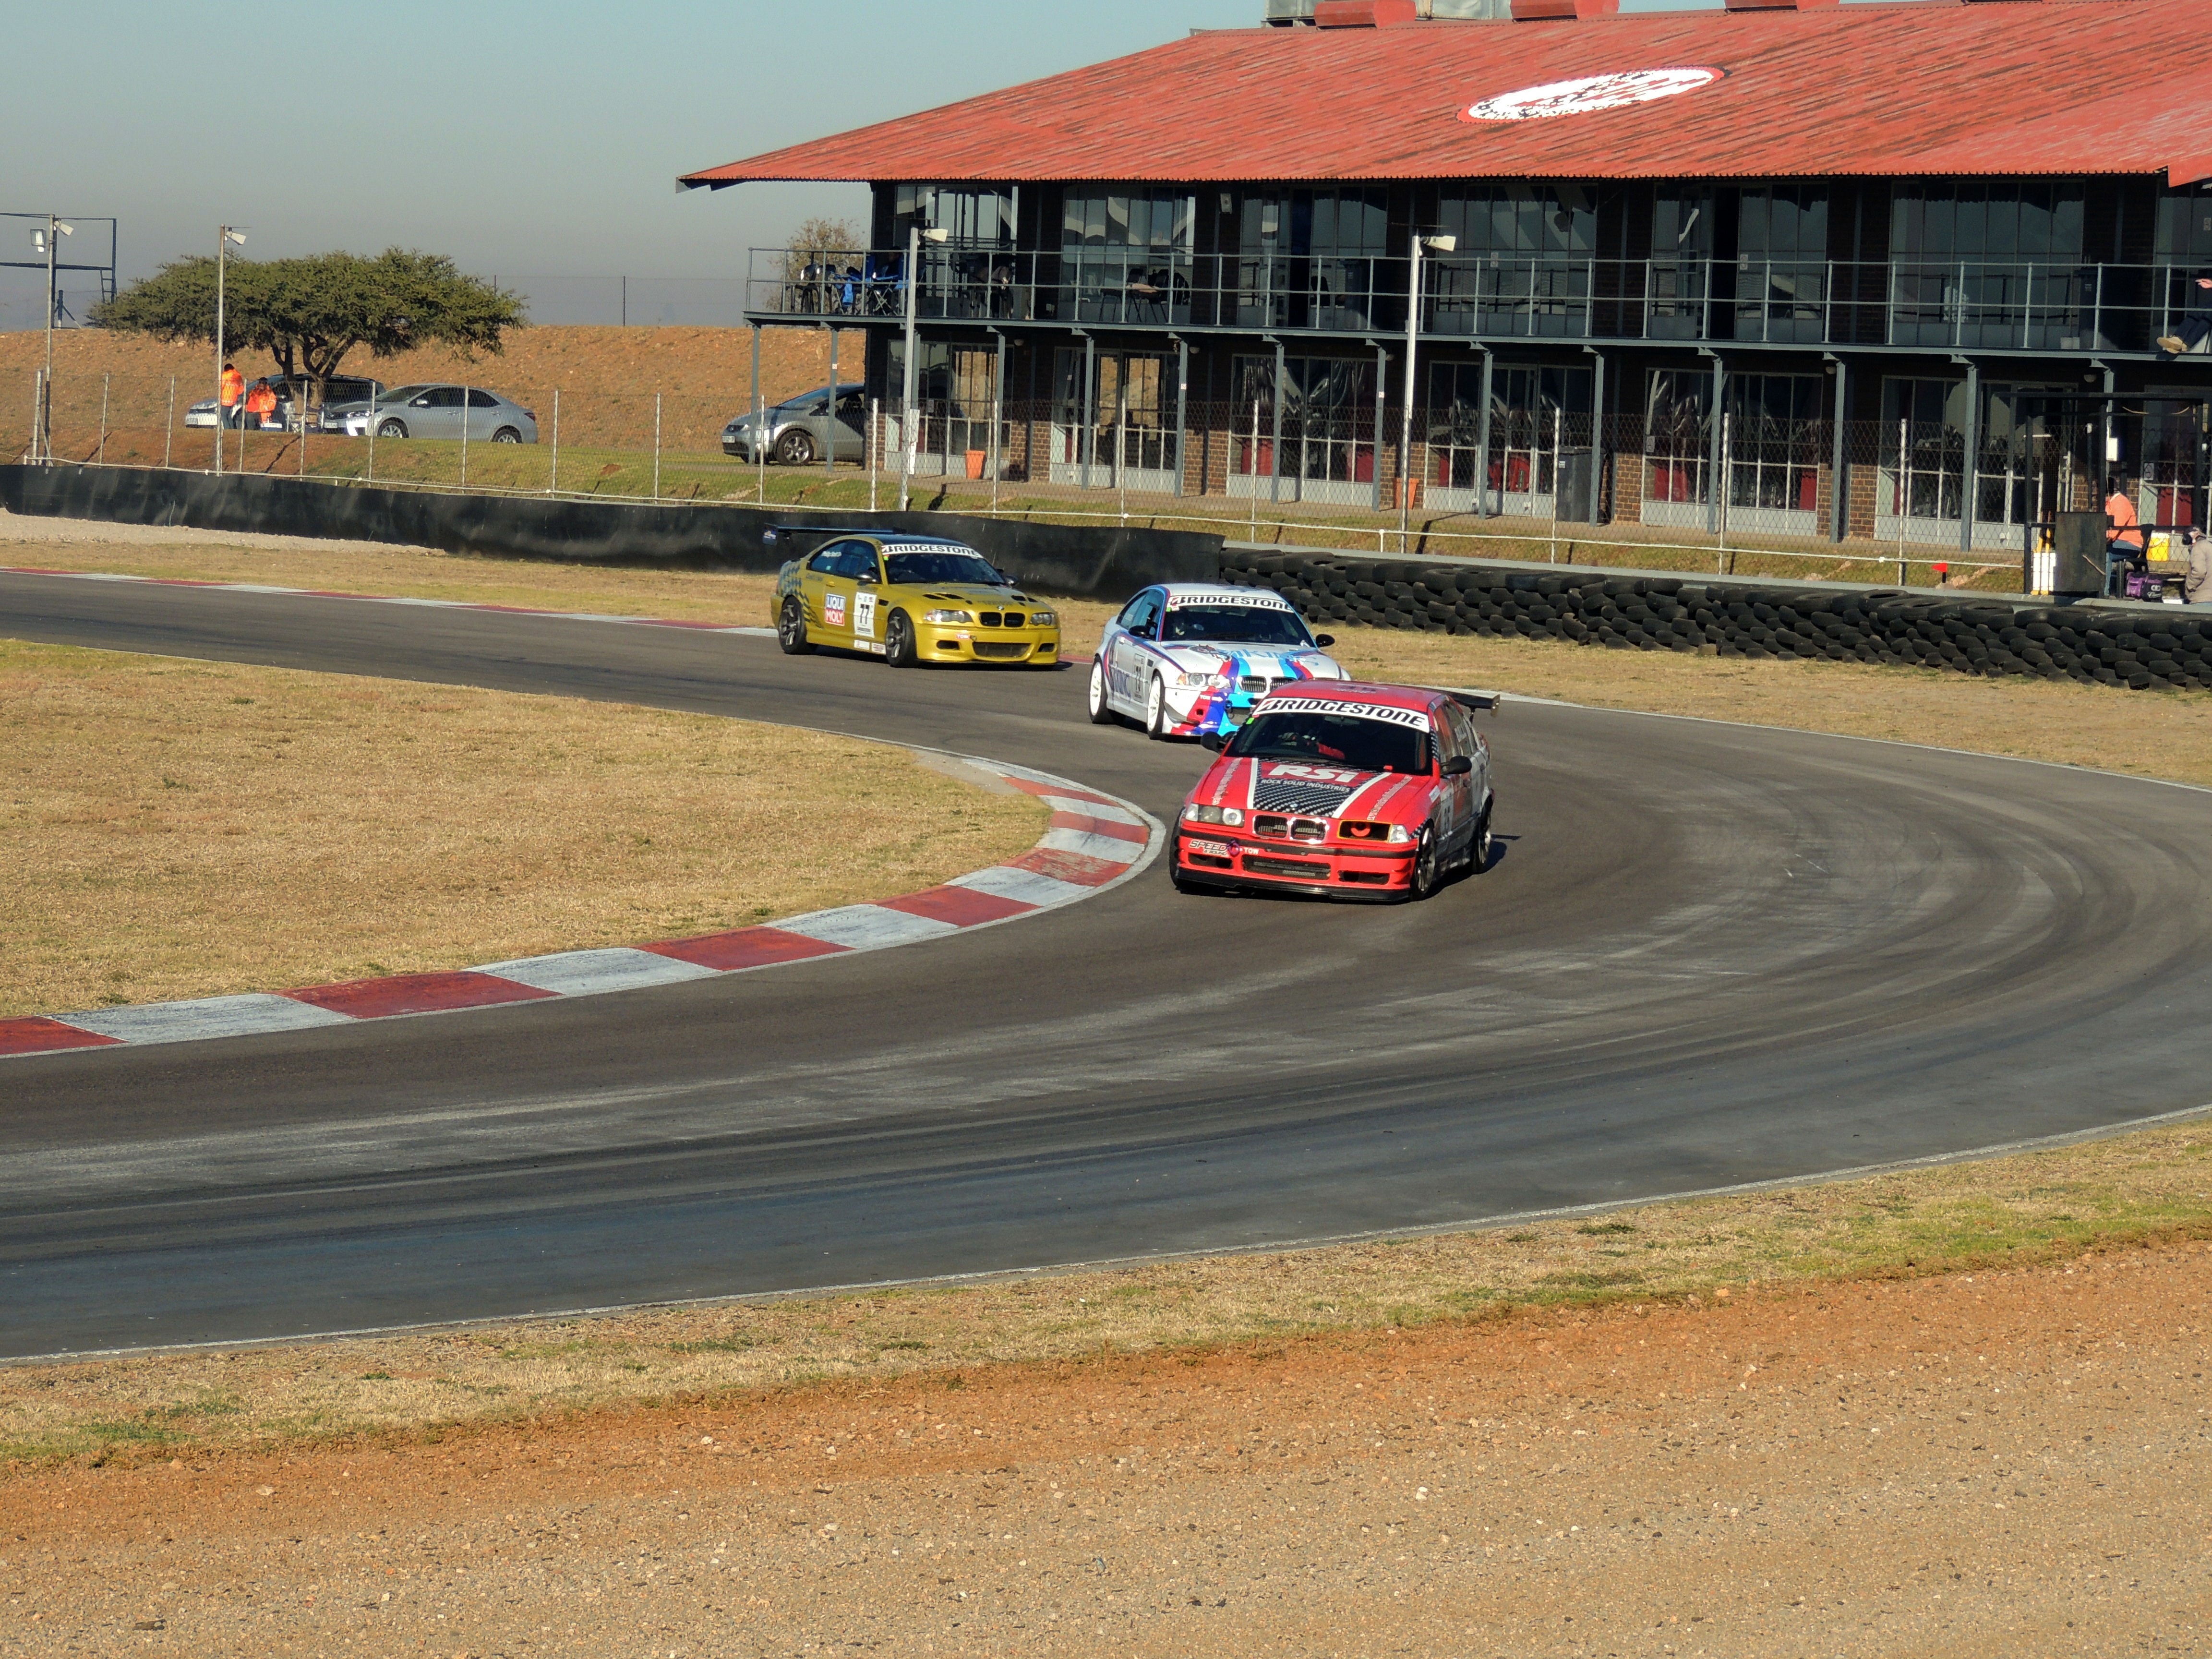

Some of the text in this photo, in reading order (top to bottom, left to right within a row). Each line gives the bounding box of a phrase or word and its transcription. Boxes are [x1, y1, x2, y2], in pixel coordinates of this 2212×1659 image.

[881, 545, 979, 557] BRIDGESTONE
[827, 595, 844, 610] LIQUI
[826, 610, 843, 624] MOLY
[860, 603, 870, 625] 77
[1256, 699, 1426, 726] BRIDGESTONE
[1306, 781, 1351, 793] INDUSTRIES
[1189, 840, 1228, 851] SPEED
